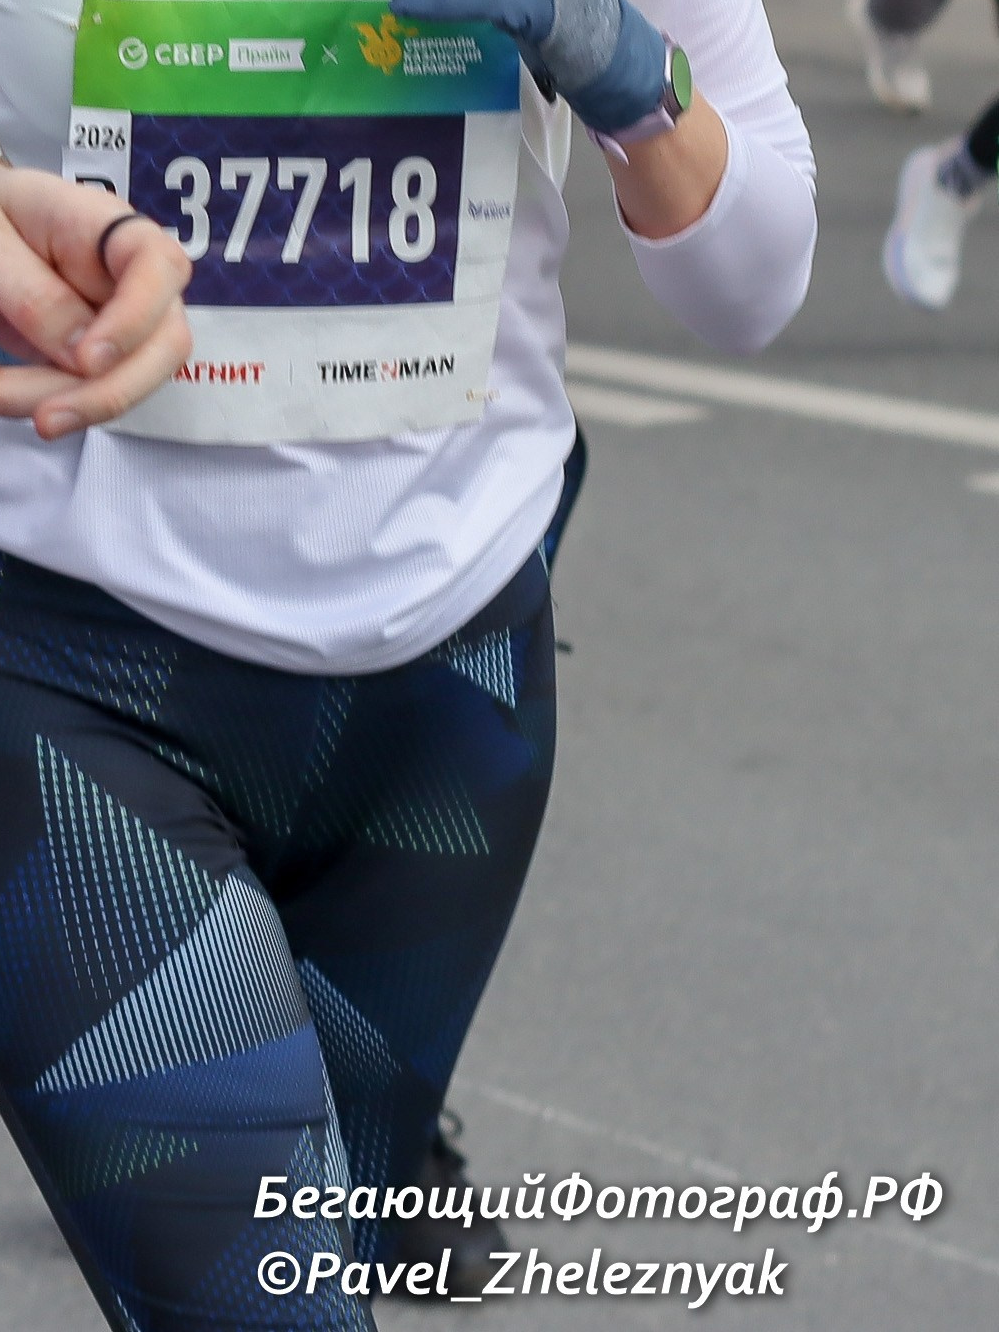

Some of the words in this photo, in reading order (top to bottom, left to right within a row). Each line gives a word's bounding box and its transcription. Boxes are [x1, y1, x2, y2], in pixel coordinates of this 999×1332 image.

[154, 42, 225, 67] СБЕР
[236, 44, 292, 66] Прайм
[73, 123, 127, 151] 2026
[163, 155, 438, 264] 37718
[171, 361, 266, 385] АГНИТ
